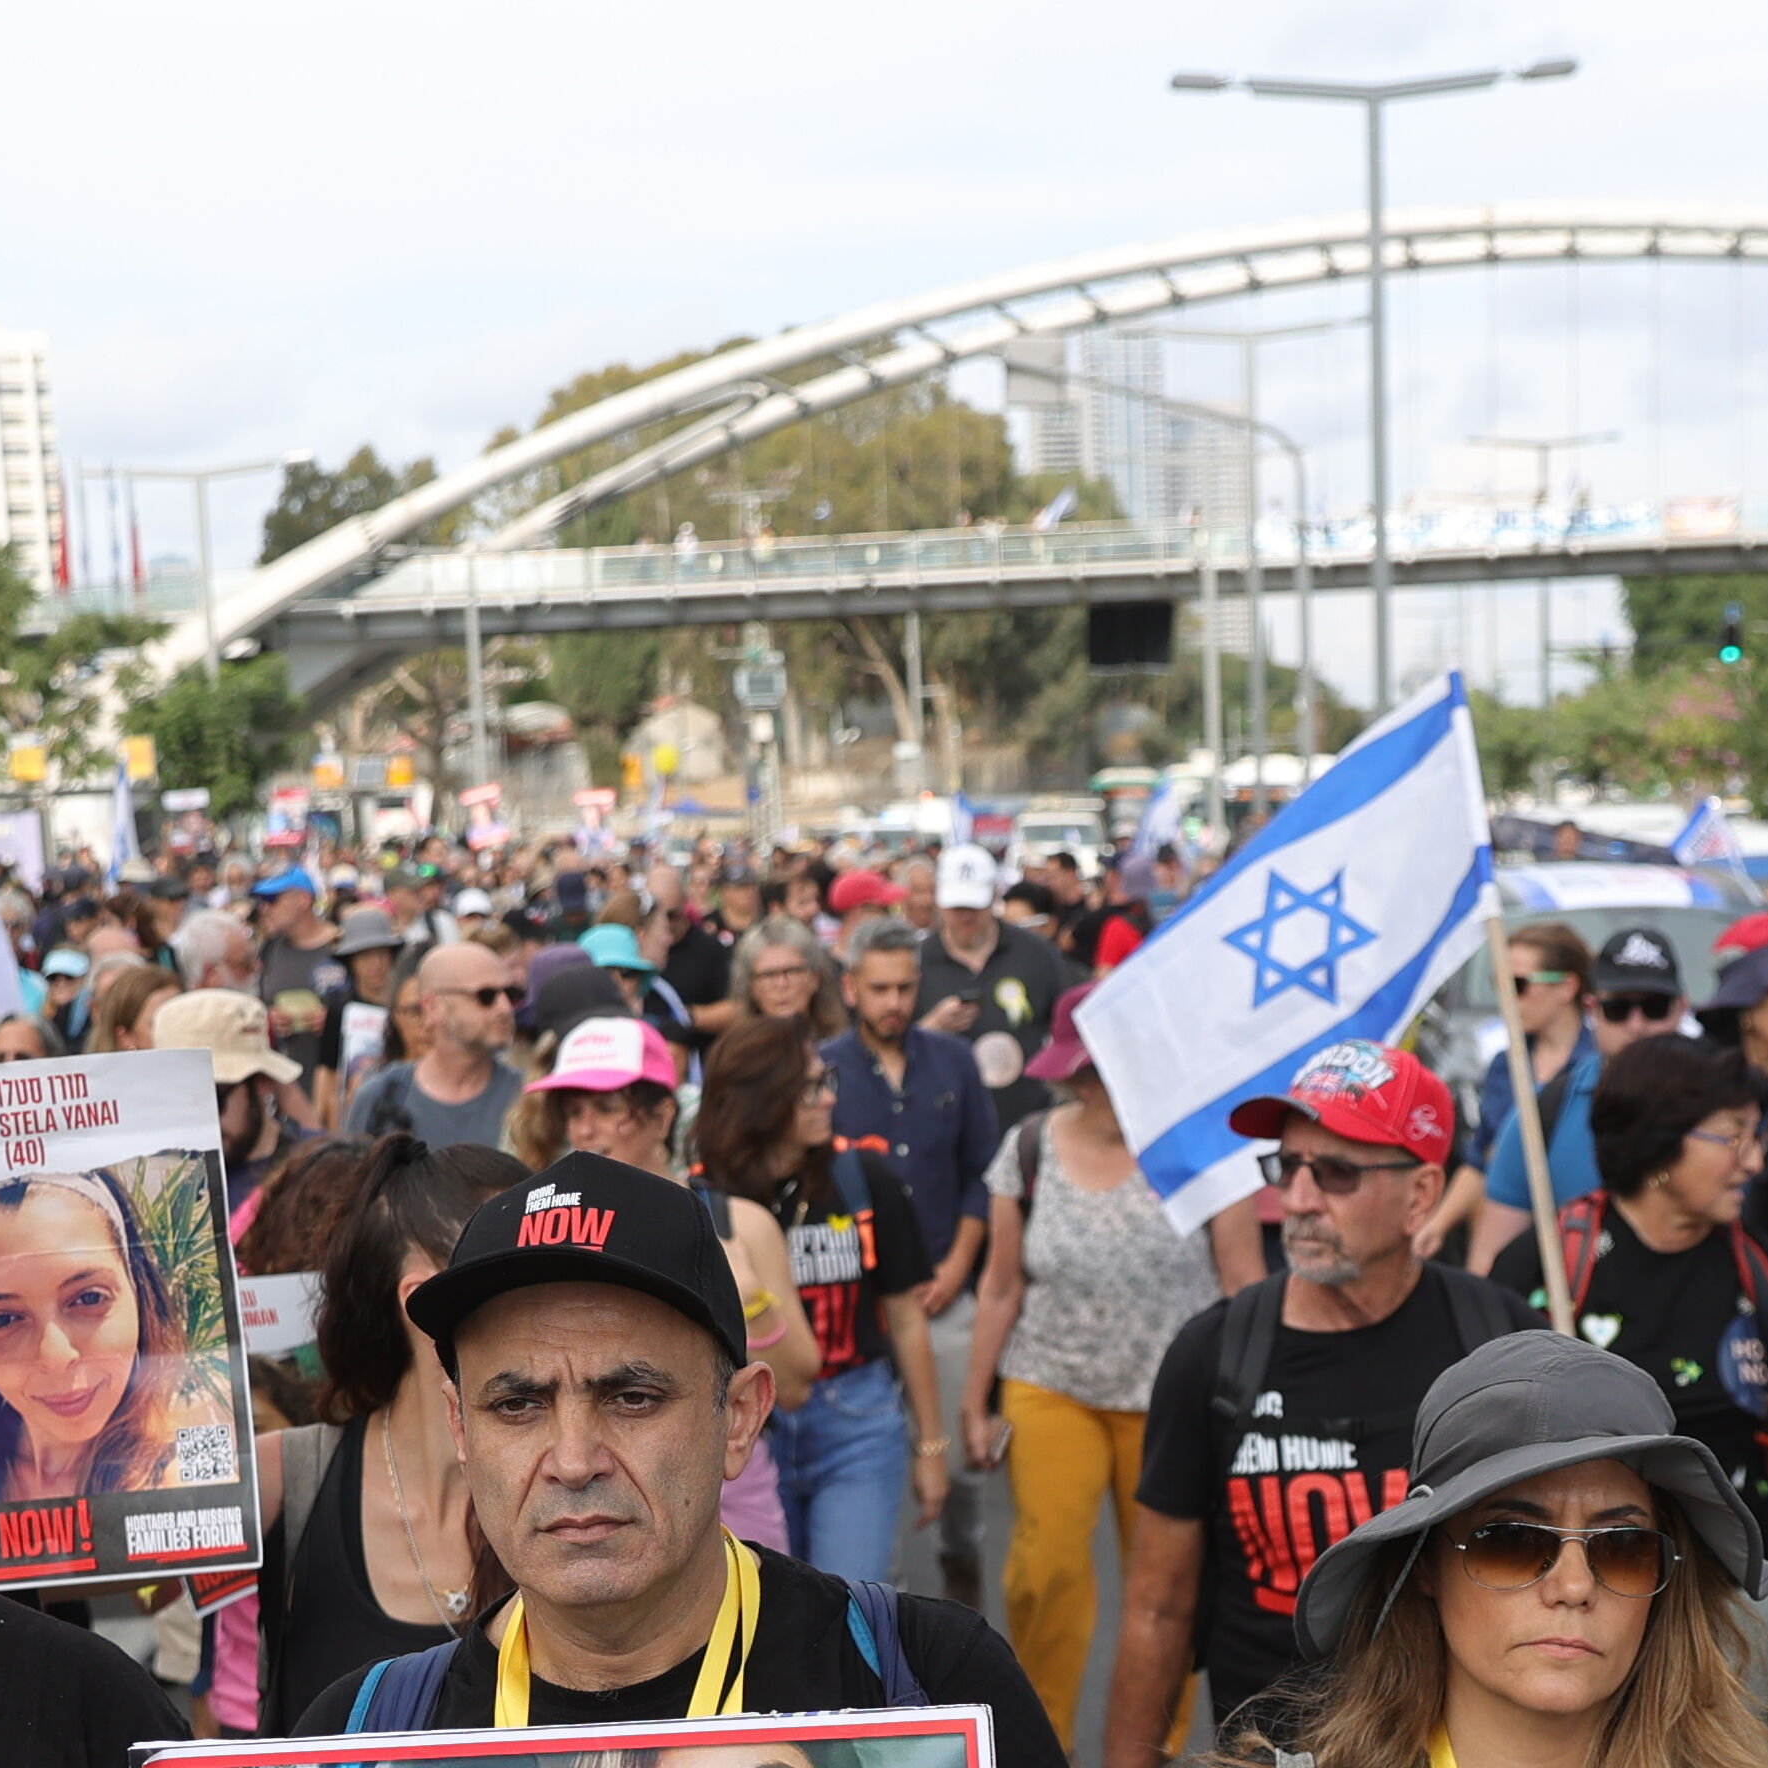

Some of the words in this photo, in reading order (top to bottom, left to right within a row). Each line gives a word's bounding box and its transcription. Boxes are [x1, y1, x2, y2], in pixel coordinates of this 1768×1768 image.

[49, 1073, 89, 1105] מורן
[0, 1105, 58, 1137] STELA
[61, 1099, 120, 1130] YANAI
[5, 1139, 46, 1171] (40)
[552, 1192, 582, 1208] HOME
[517, 1206, 616, 1248] NOW
[1230, 1431, 1280, 1475] HEM
[0, 1498, 94, 1559] NOW!
[124, 1512, 176, 1534] HOSTAGES
[176, 1510, 197, 1529] AND
[198, 1505, 243, 1527] MISSING
[127, 1528, 190, 1555] FAMILIES
[192, 1523, 244, 1550] FORUM
